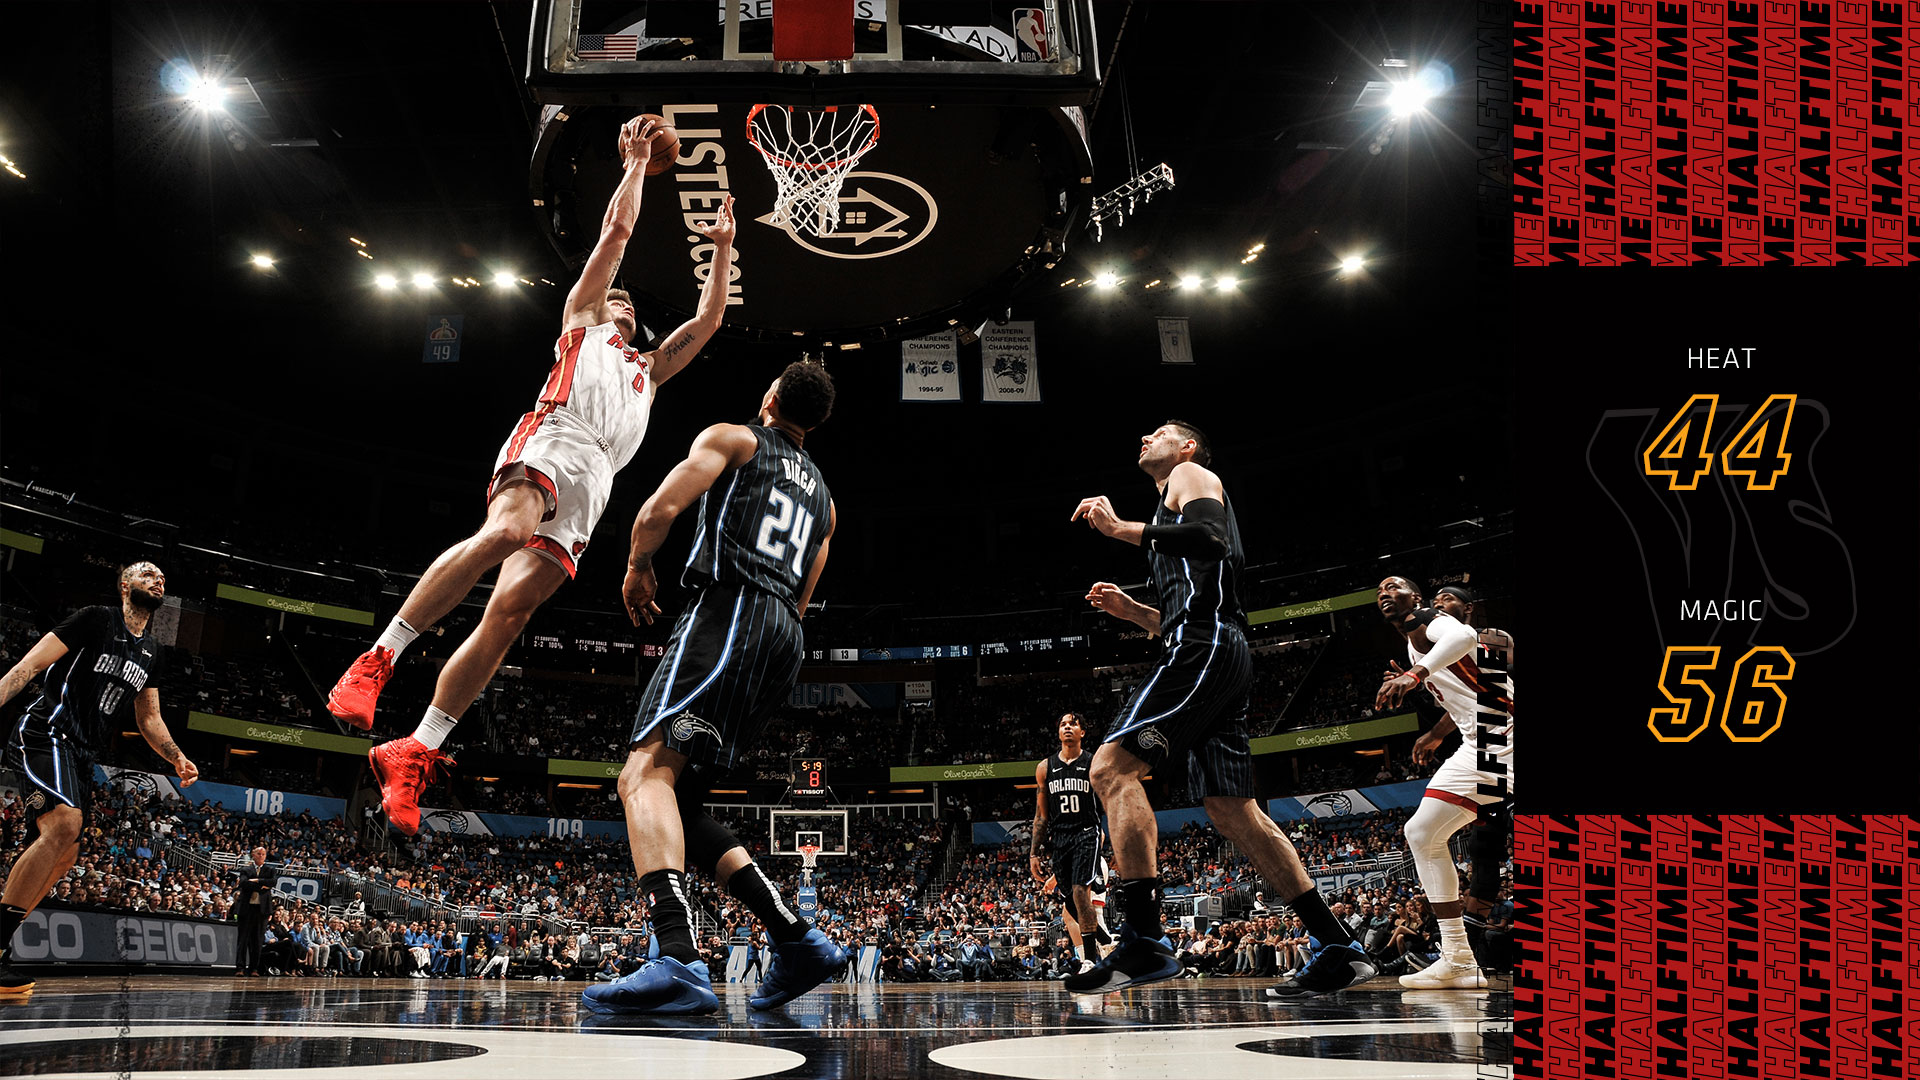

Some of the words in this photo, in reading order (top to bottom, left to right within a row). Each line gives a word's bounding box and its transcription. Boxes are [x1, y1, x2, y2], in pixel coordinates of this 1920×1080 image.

[1020, 51, 1037, 62] NBA
[433, 345, 450, 360] 49
[632, 372, 645, 393] 0
[781, 458, 816, 497] BIRCH
[756, 486, 814, 578] 24
[657, 646, 664, 656] 3
[812, 650, 824, 660] 1ST
[840, 650, 849, 660] 13
[936, 646, 942, 657] 2
[962, 645, 968, 656] 6
[94, 653, 148, 692] ORLANDO
[99, 682, 125, 715] 10
[801, 761, 822, 771] 5:19
[809, 771, 820, 787] 8
[1049, 778, 1090, 795] ORLANDO
[244, 787, 285, 816] 108
[1060, 795, 1080, 814] 20
[547, 818, 584, 840] 109
[116, 917, 219, 963] GEICO
